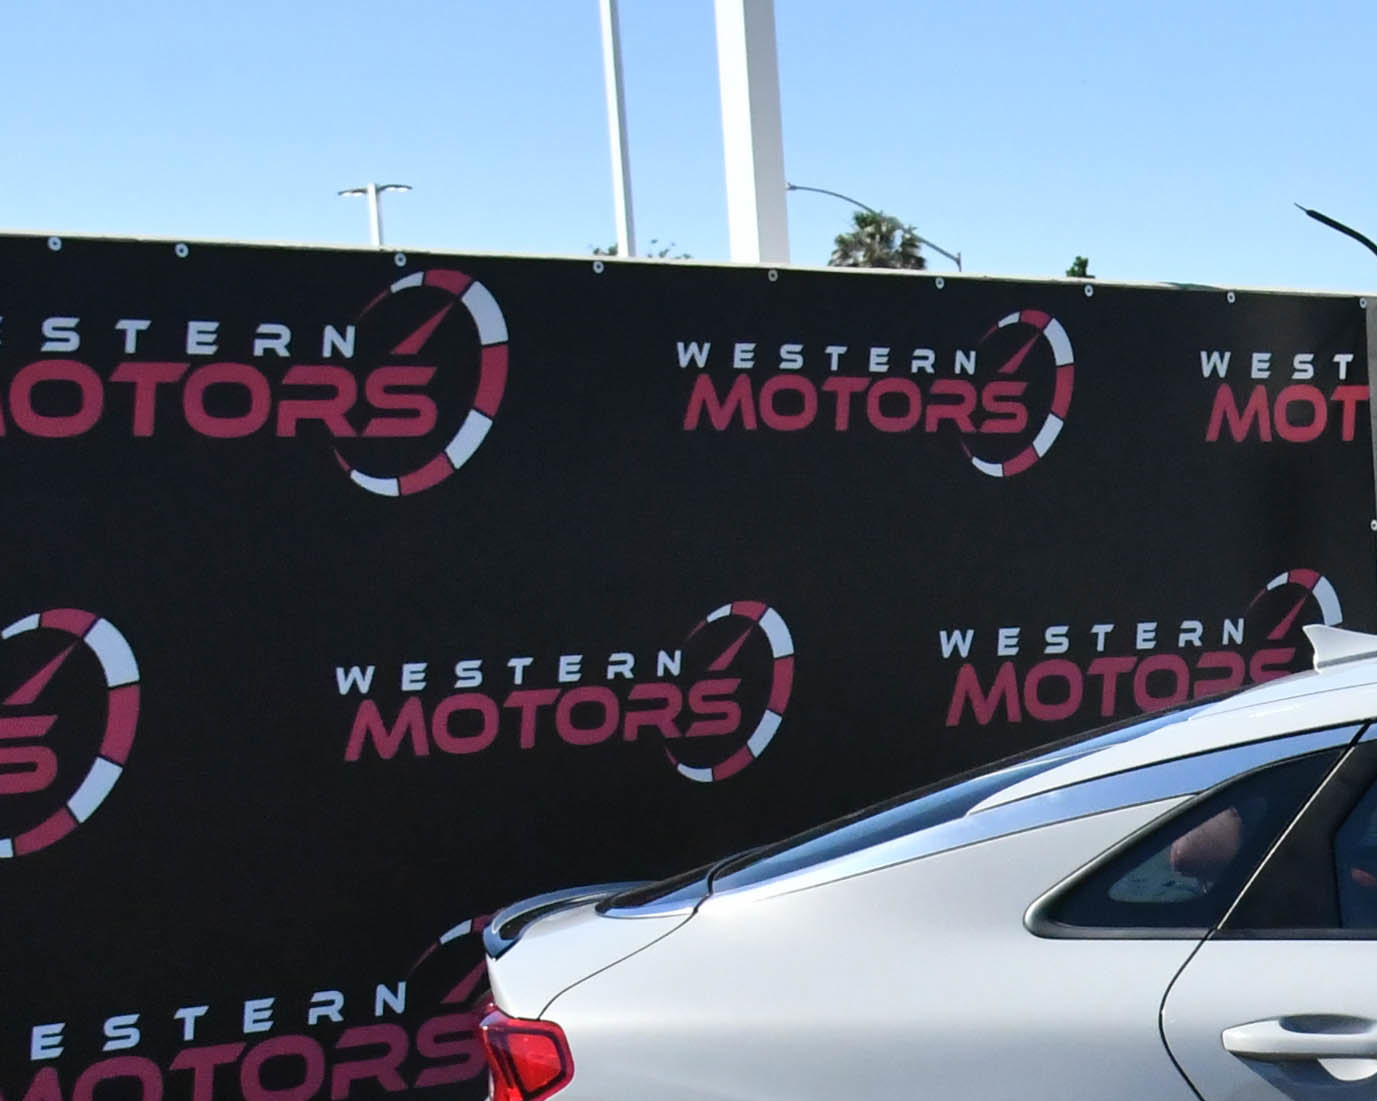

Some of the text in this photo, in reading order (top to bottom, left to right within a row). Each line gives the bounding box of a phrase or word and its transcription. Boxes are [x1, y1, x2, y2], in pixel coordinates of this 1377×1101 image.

[0, 316, 356, 358] STERN
[677, 341, 976, 375] WESTERN
[1200, 350, 1354, 380] WEST
[0, 359, 436, 438] OTORS
[684, 374, 1027, 433] MOTORS
[1205, 383, 1371, 443] MOT
[939, 618, 1244, 660] WESTERN
[336, 650, 682, 695] WESTERN
[344, 679, 742, 761] MOTORS
